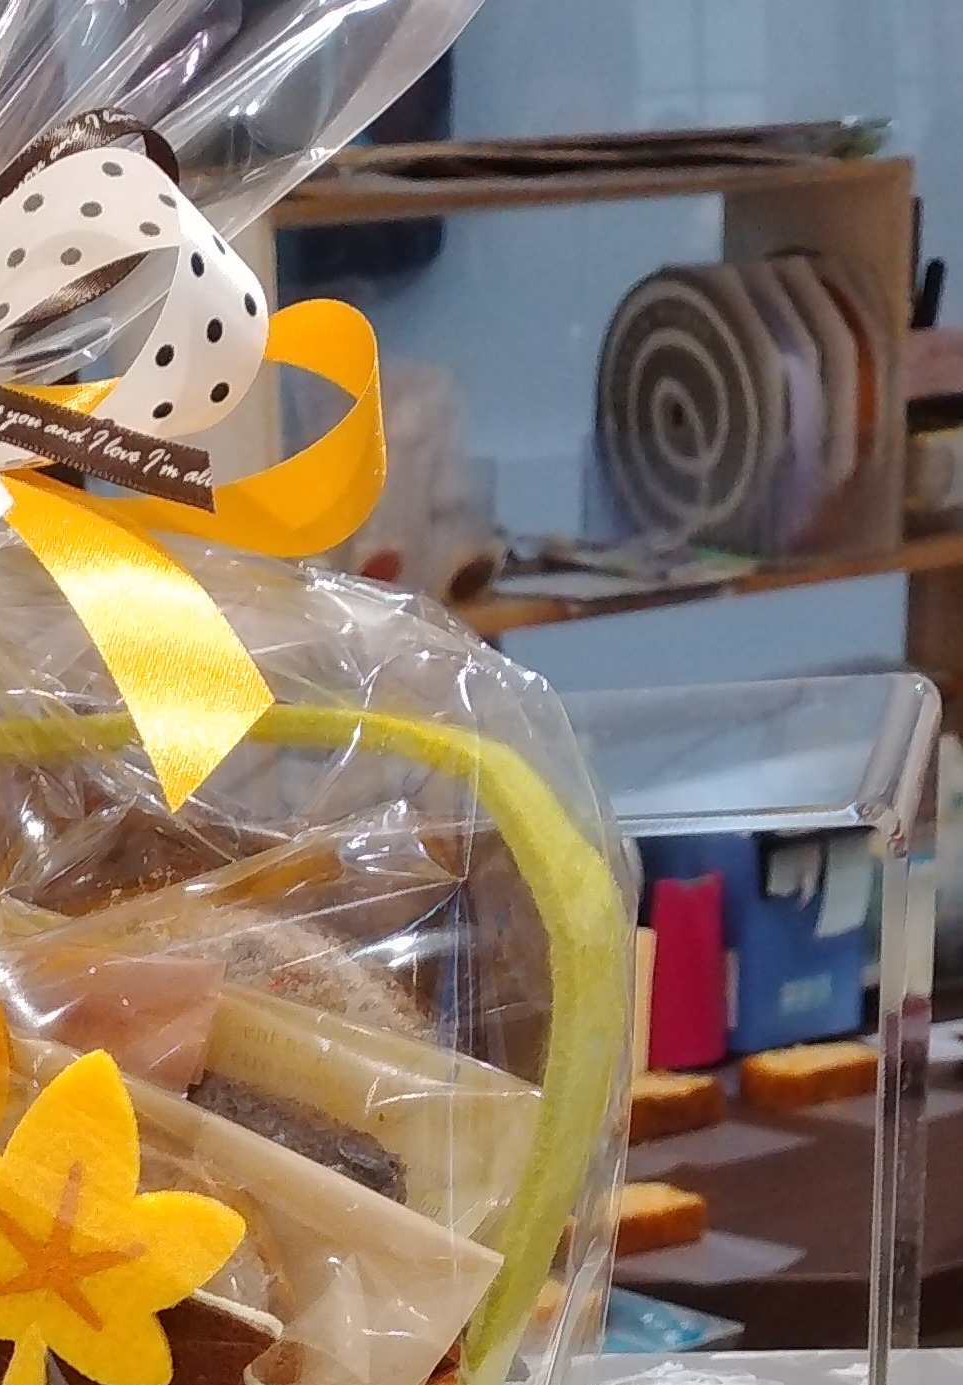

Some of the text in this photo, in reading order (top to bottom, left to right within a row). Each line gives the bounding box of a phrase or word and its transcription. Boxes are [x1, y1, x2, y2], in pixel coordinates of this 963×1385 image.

[0, 409, 42, 431] you
[43, 424, 92, 444] and
[103, 436, 141, 463] love
[142, 448, 180, 478] I'm
